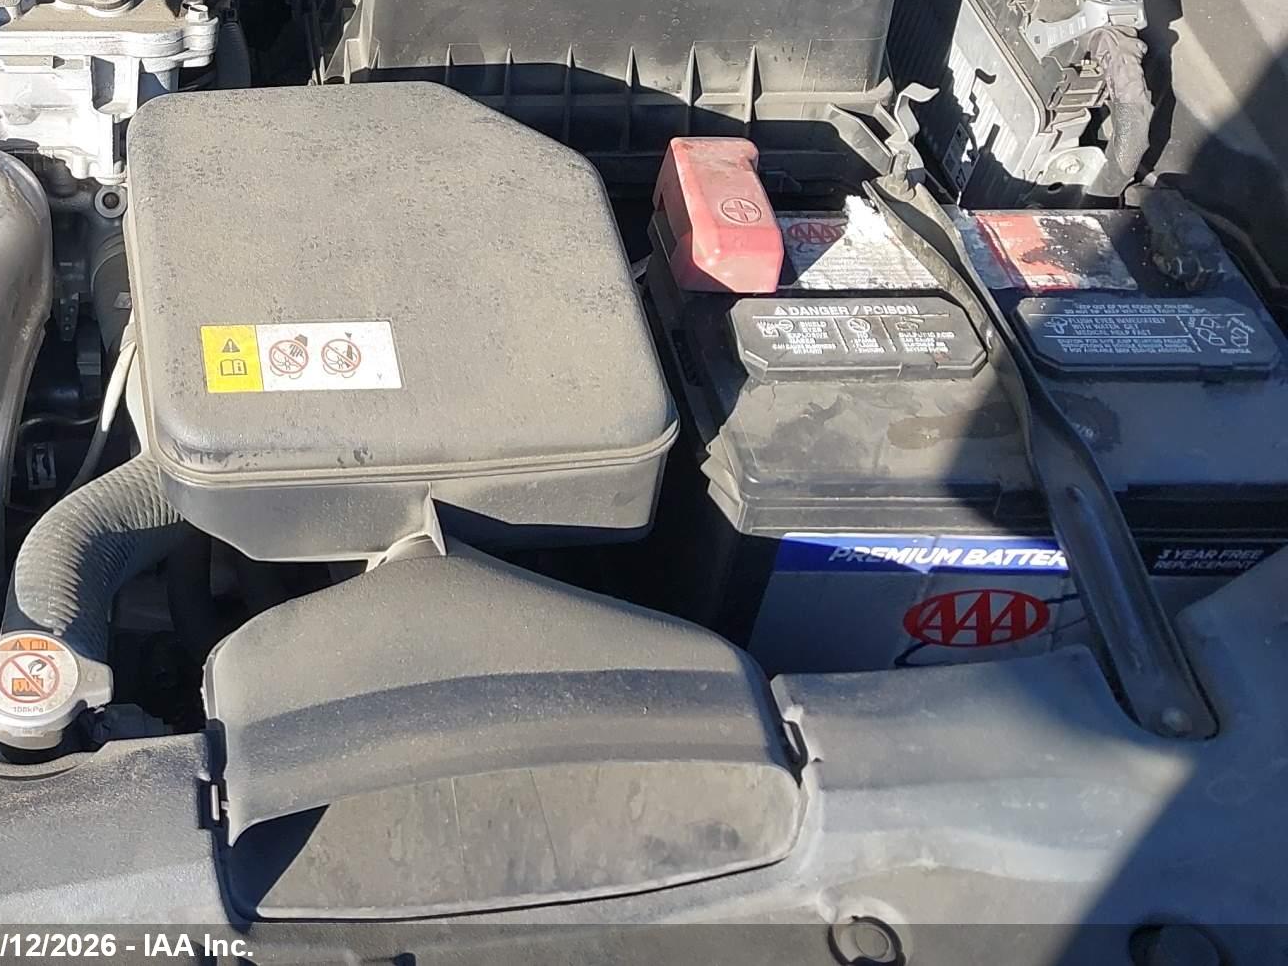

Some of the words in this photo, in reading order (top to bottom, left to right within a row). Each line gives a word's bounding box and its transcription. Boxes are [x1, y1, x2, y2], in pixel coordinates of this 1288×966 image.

[789, 306, 850, 315] DANGER
[852, 306, 860, 315] /
[863, 305, 920, 315] POISON
[829, 547, 962, 566] PREMIUM
[961, 548, 1069, 566] BATTER
[1174, 549, 1218, 560] YEAR
[1219, 549, 1264, 560] FREE
[915, 590, 1038, 646] AAA
